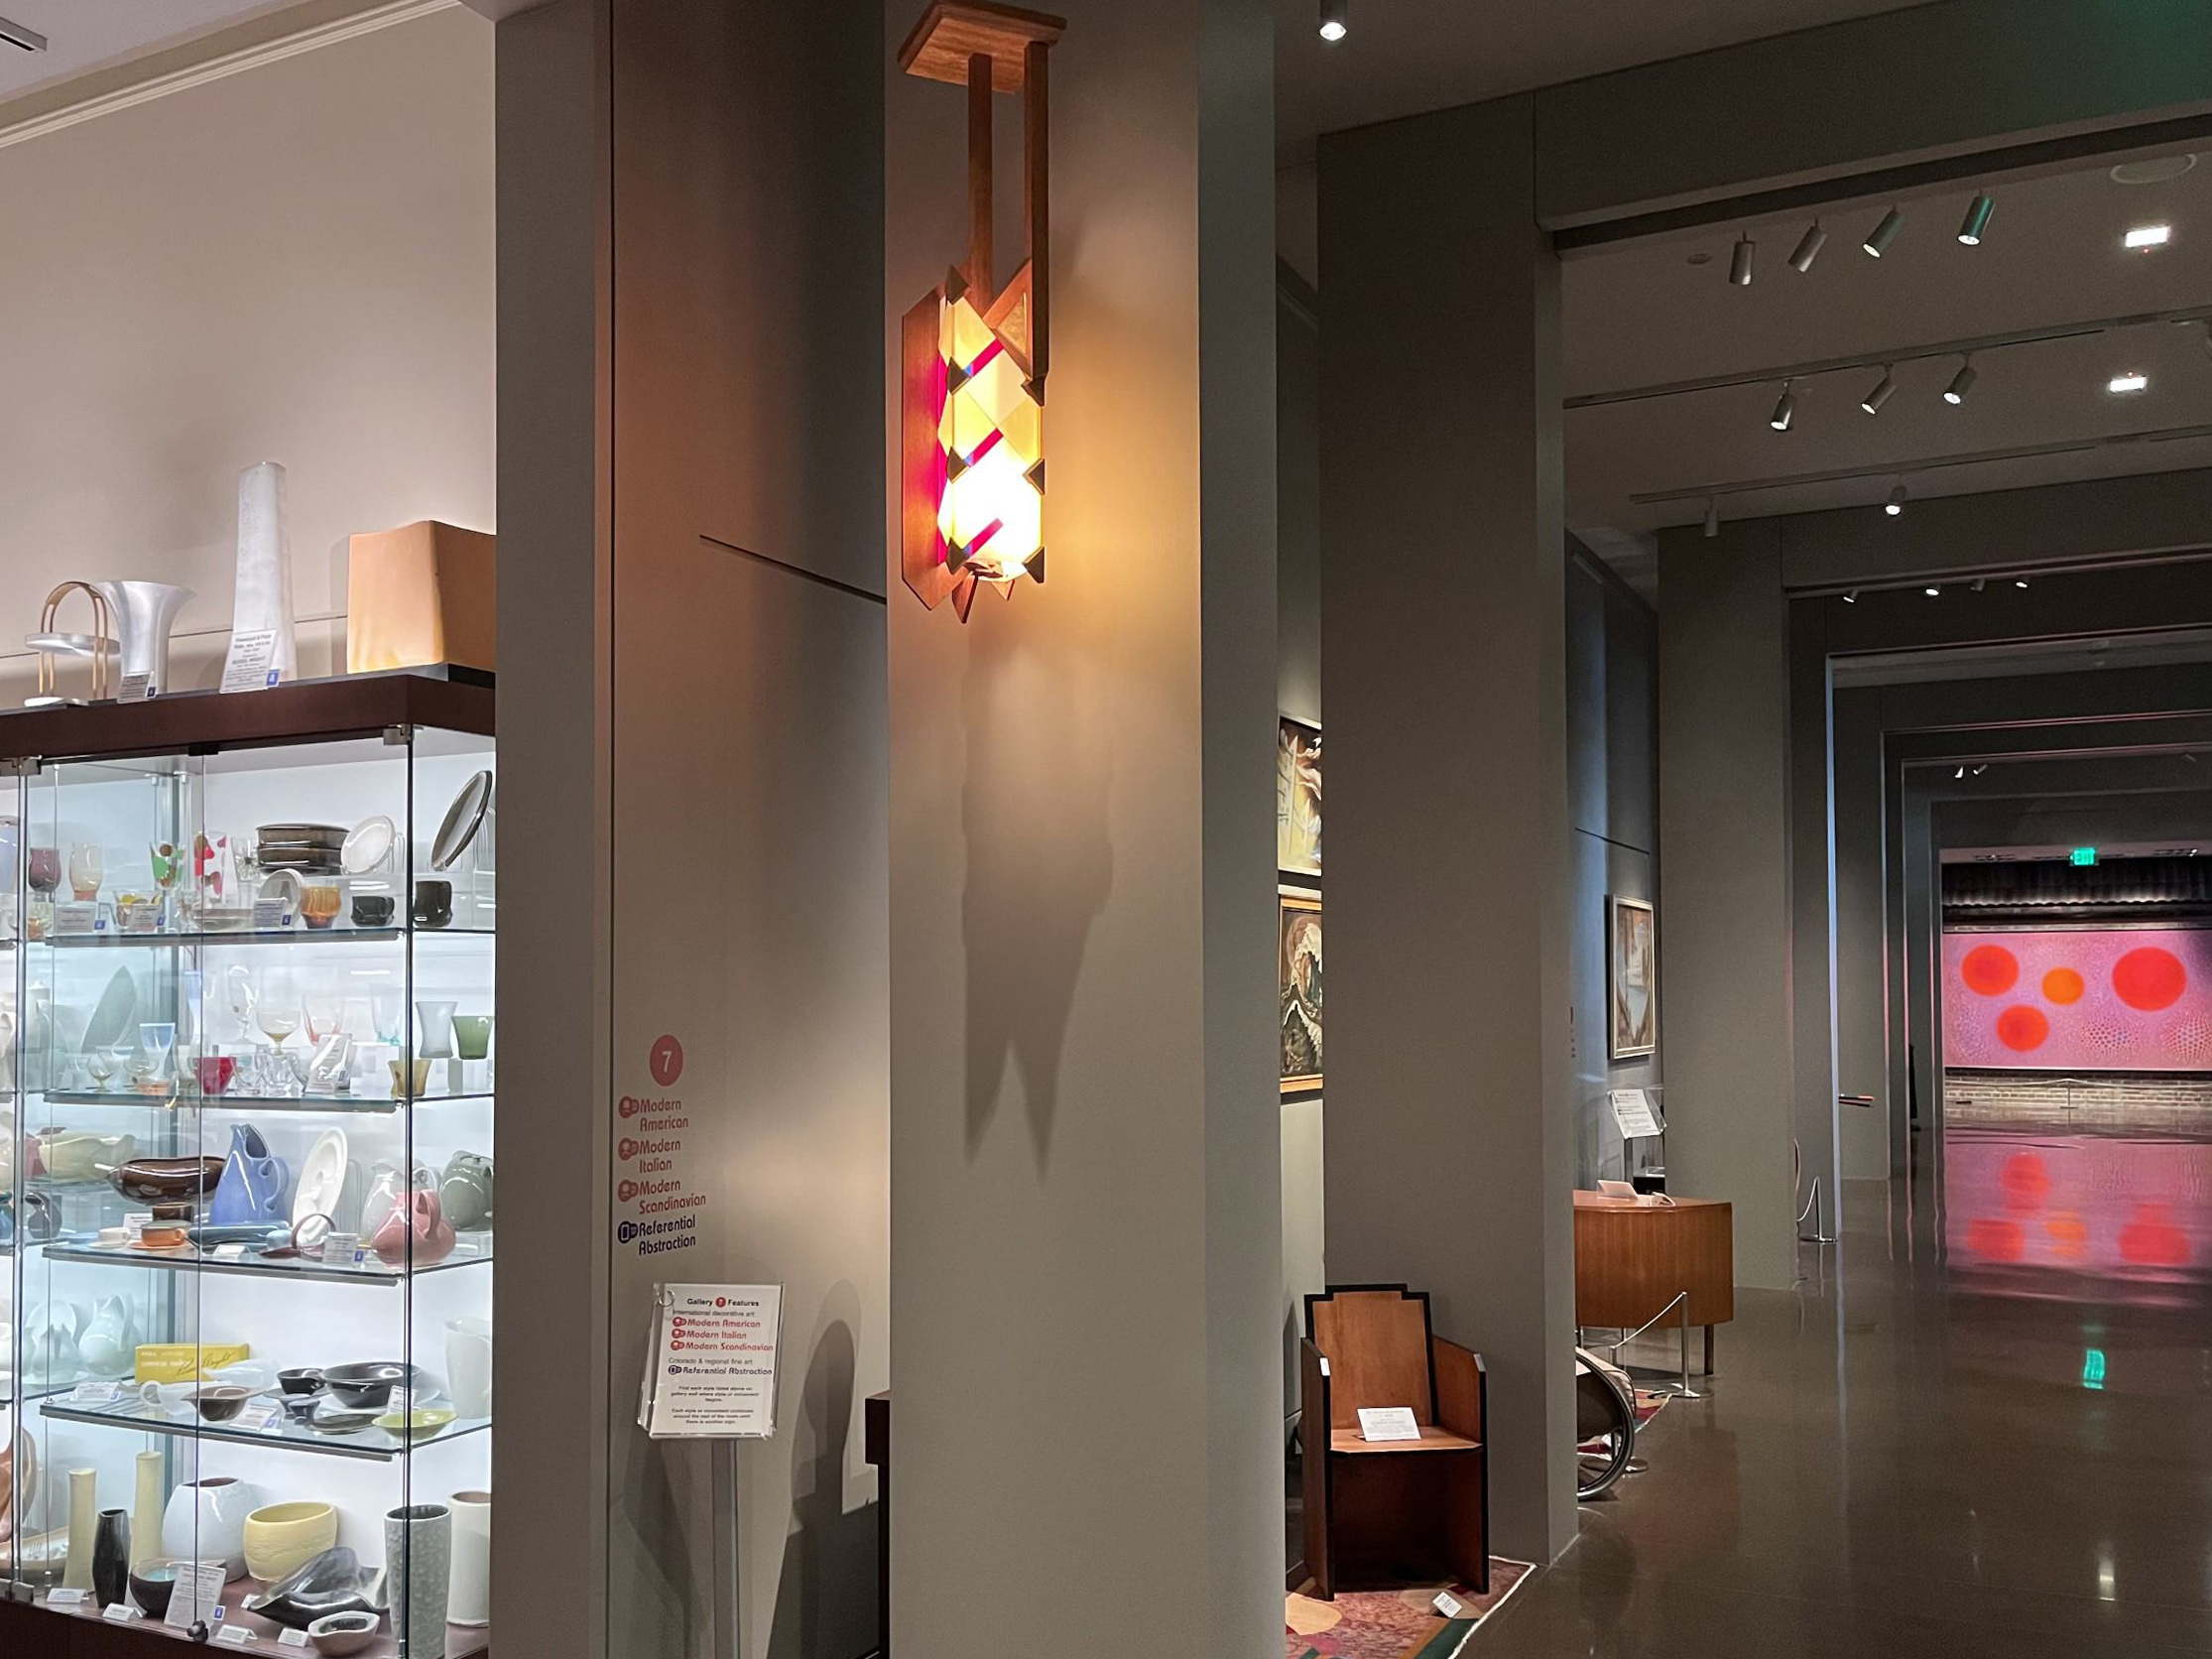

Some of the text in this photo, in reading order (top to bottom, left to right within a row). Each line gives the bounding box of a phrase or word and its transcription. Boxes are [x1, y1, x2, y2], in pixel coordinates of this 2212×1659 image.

[662, 1051, 672, 1073] 7
[640, 1098, 681, 1113] Modern
[640, 1114, 688, 1132] American
[639, 1137, 681, 1155] Modern
[639, 1157, 673, 1174] Italian
[639, 1179, 680, 1196] Modern
[639, 1193, 706, 1214] Scandinavian
[639, 1214, 695, 1237] Referential
[638, 1233, 696, 1255] Abstraction
[686, 1298, 713, 1307] Gallery
[722, 1319, 761, 1328] American
[685, 1330, 747, 1340] Modern Italian
[684, 1341, 774, 1351] Modern Scandinavian
[728, 1367, 773, 1376] Abstraction
